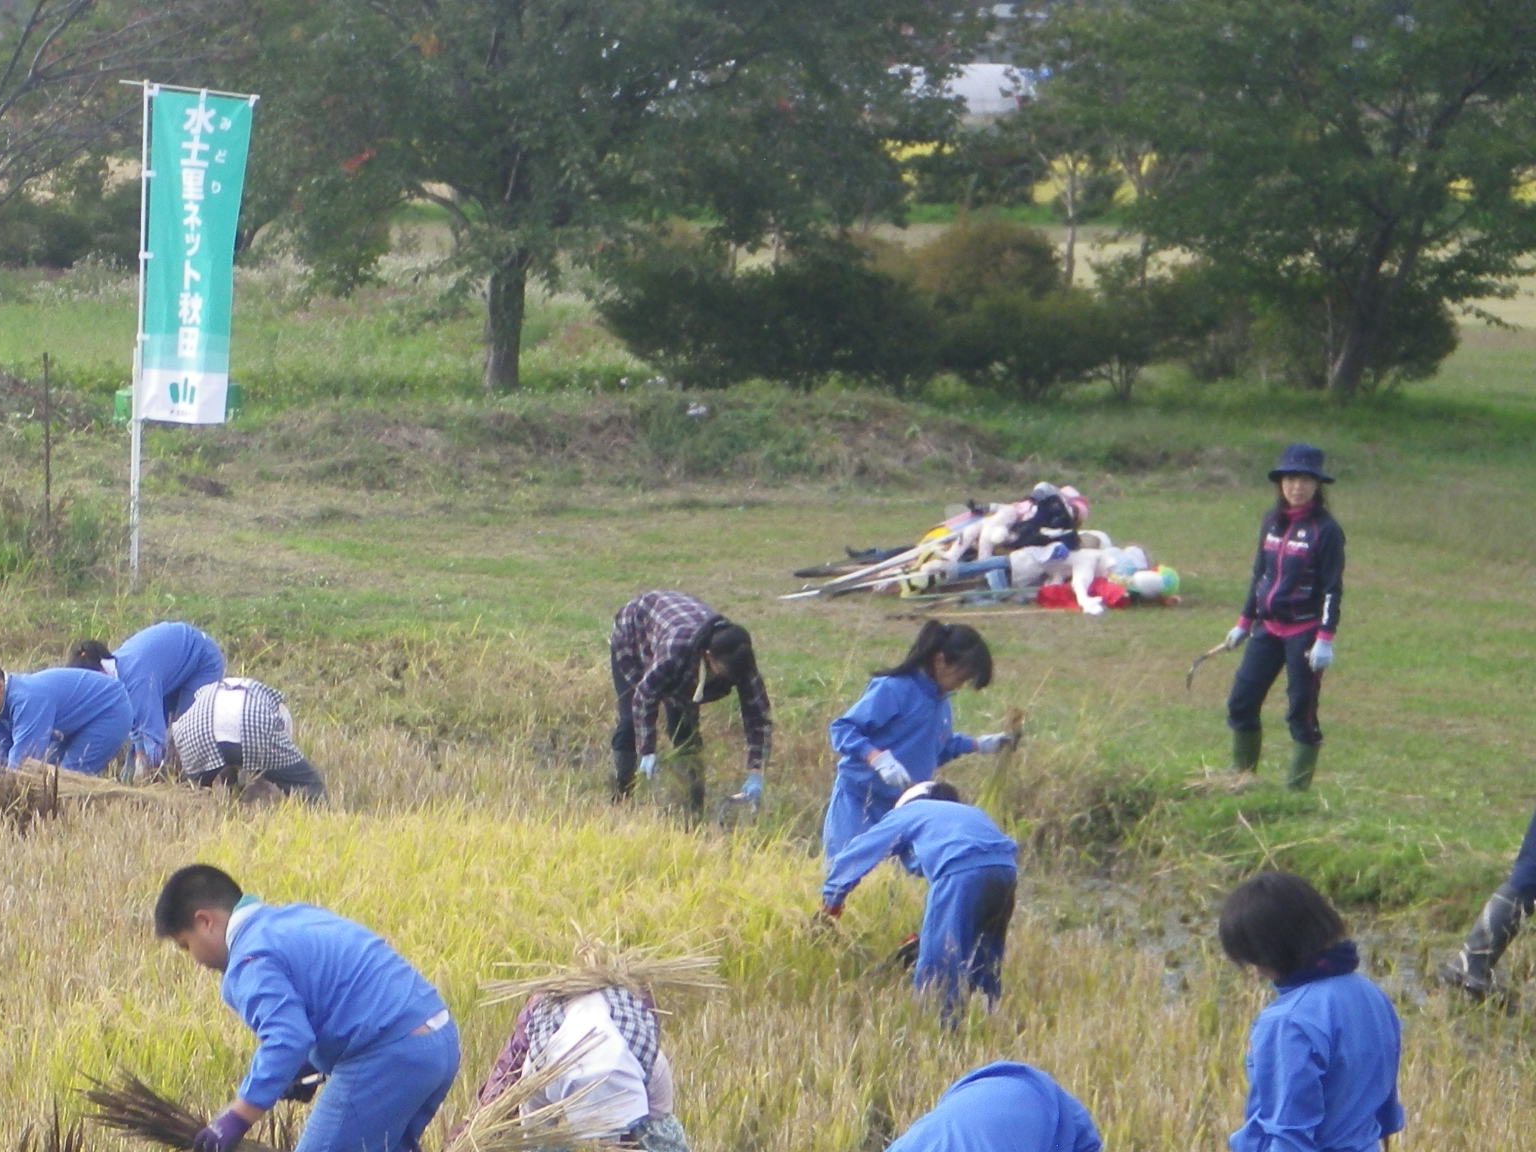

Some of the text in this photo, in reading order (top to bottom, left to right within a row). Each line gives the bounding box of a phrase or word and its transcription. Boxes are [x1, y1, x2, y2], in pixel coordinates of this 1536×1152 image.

[177, 107, 215, 359] 水土里ネット秋田
